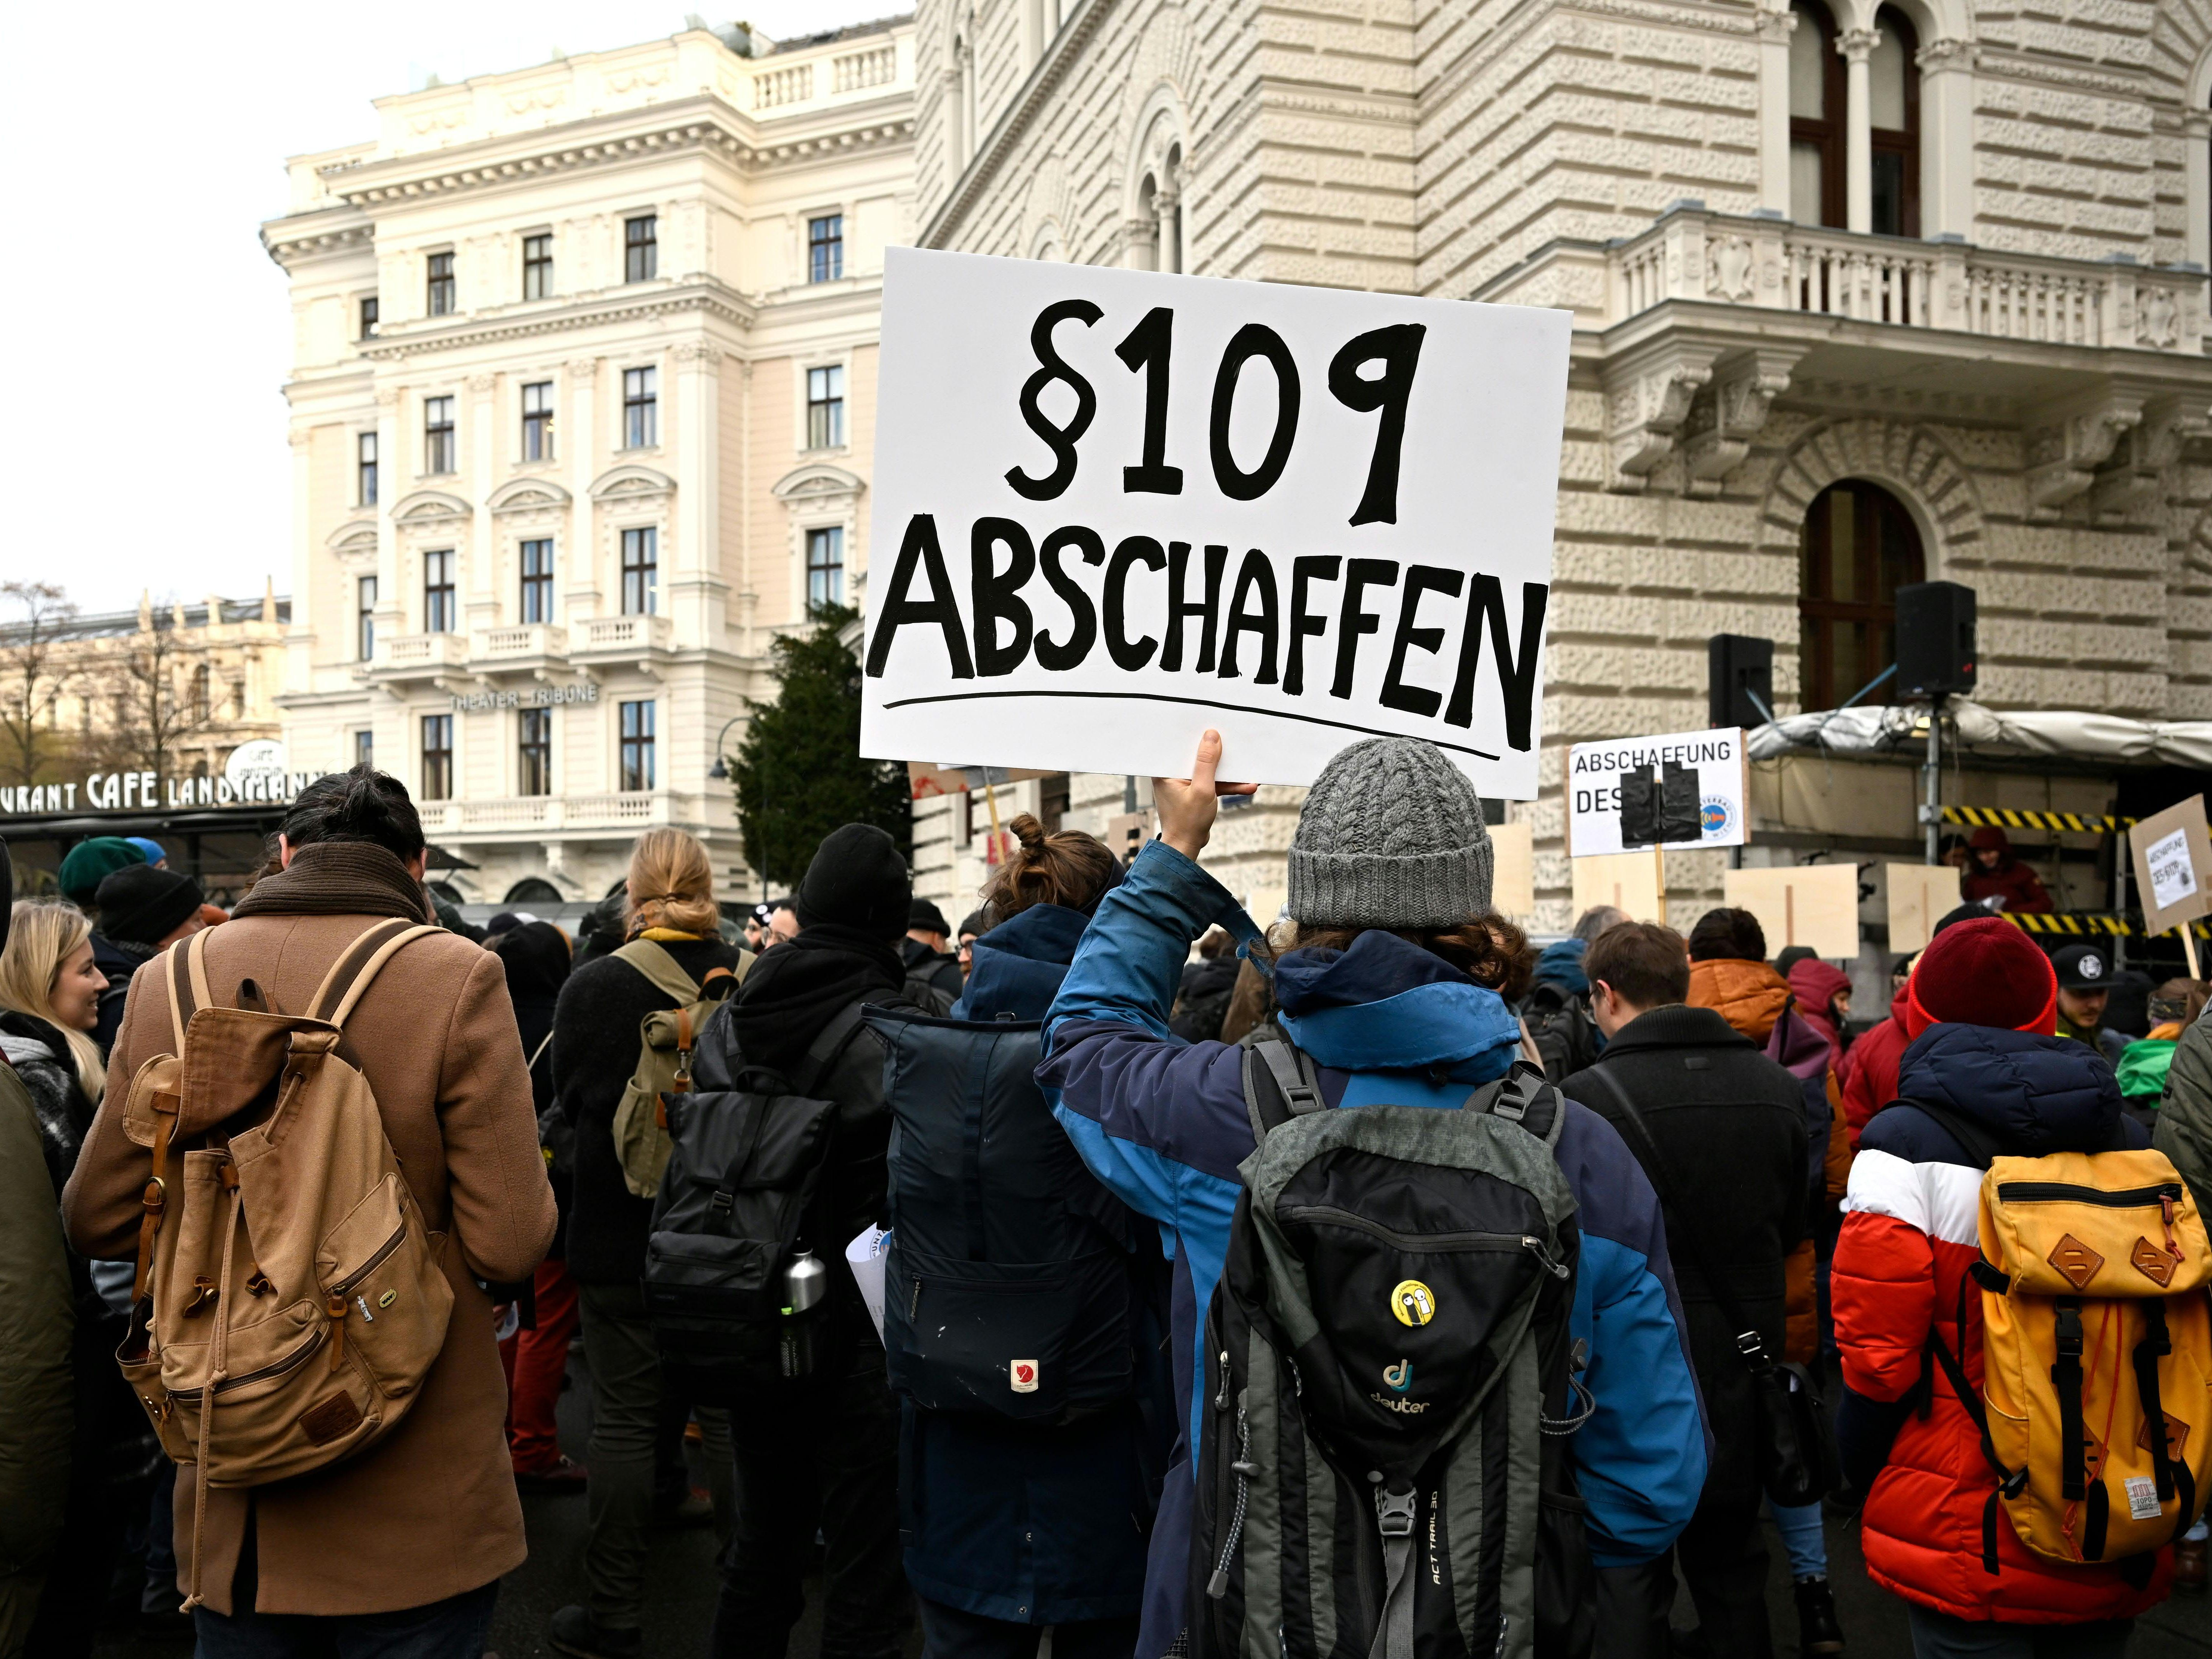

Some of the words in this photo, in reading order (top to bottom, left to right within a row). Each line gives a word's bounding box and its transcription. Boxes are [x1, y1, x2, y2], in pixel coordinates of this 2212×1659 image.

[1004, 299, 1426, 526] §109
[866, 513, 1548, 751] ABSCHAFFEN
[450, 690, 520, 710] THEATER
[530, 683, 599, 704] TRIBÜNE
[1575, 741, 1730, 773] ABSCHAFFUNG
[87, 771, 158, 809] CAFE
[1577, 787, 1622, 814] DES
[381, 1292, 395, 1305] YAY!
[1370, 1392, 1430, 1414] deuter
[1431, 1491, 1438, 1509] 3D
[1430, 1554, 1441, 1585] ACT
